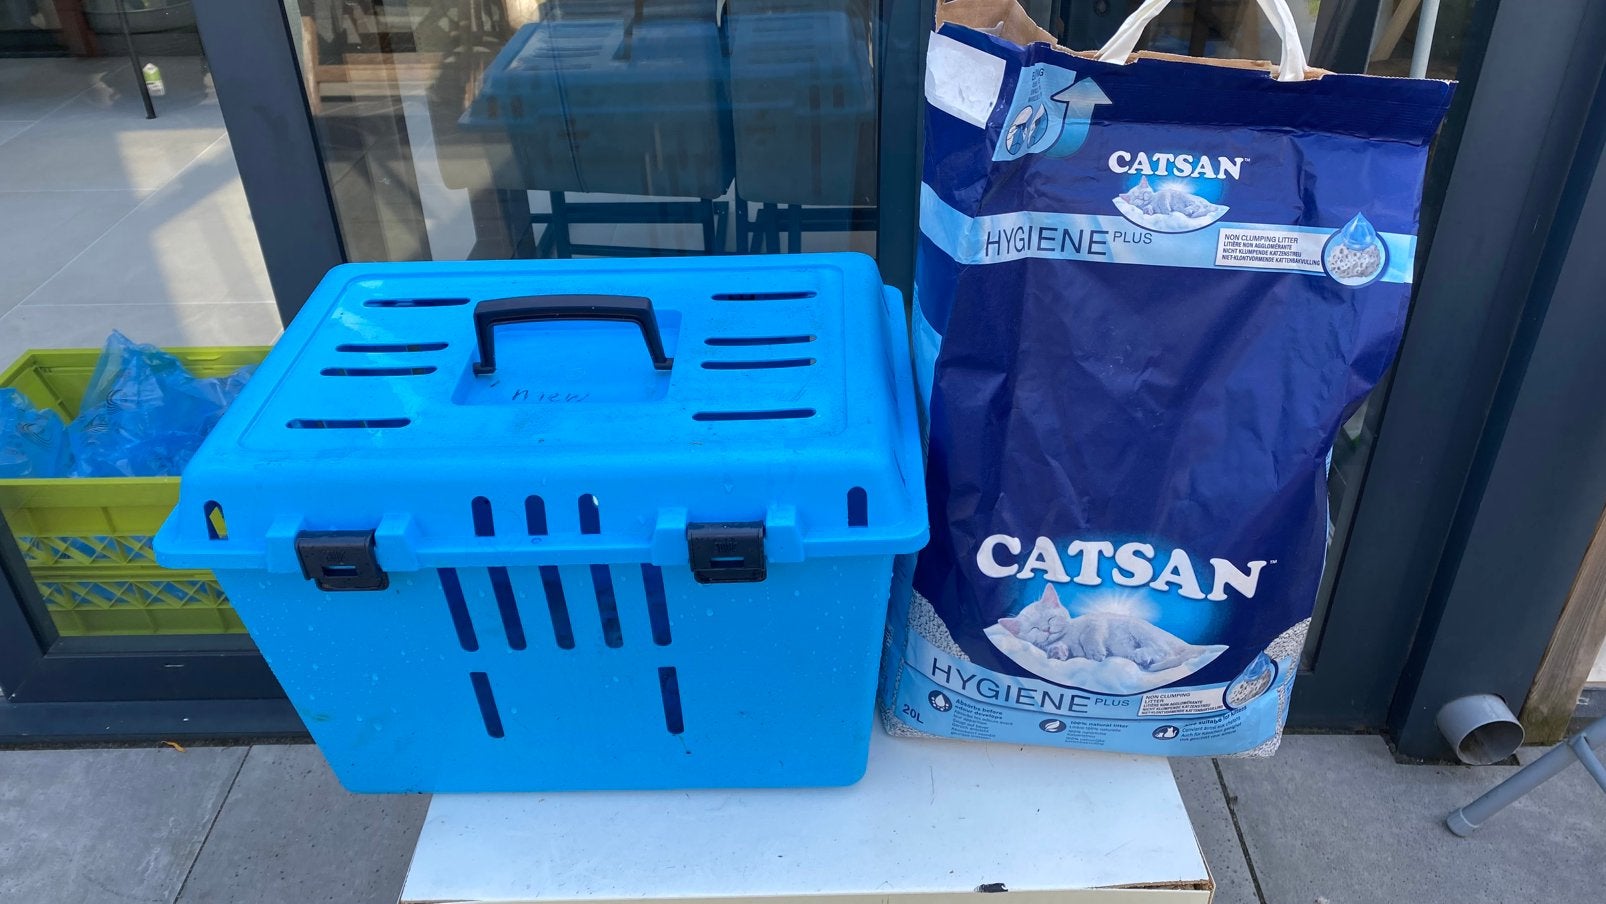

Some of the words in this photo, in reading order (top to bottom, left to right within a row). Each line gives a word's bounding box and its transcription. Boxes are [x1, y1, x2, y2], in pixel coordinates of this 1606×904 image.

[1108, 150, 1244, 180] CATSAN
[985, 225, 1109, 257] HYGIENE
[1113, 230, 1153, 245] PLUS
[1224, 233, 1240, 242] NON
[1240, 234, 1277, 243] CLUMPING
[1277, 236, 1299, 244] LITTER
[1269, 250, 1302, 258] KATZENSTREU
[976, 533, 1267, 602] CATSAN
[931, 657, 1091, 714] HYGIENE
[1094, 697, 1130, 707] PLUS
[902, 703, 924, 725] 20L
[955, 698, 981, 712] Absorbs
[982, 706, 1003, 716] before
